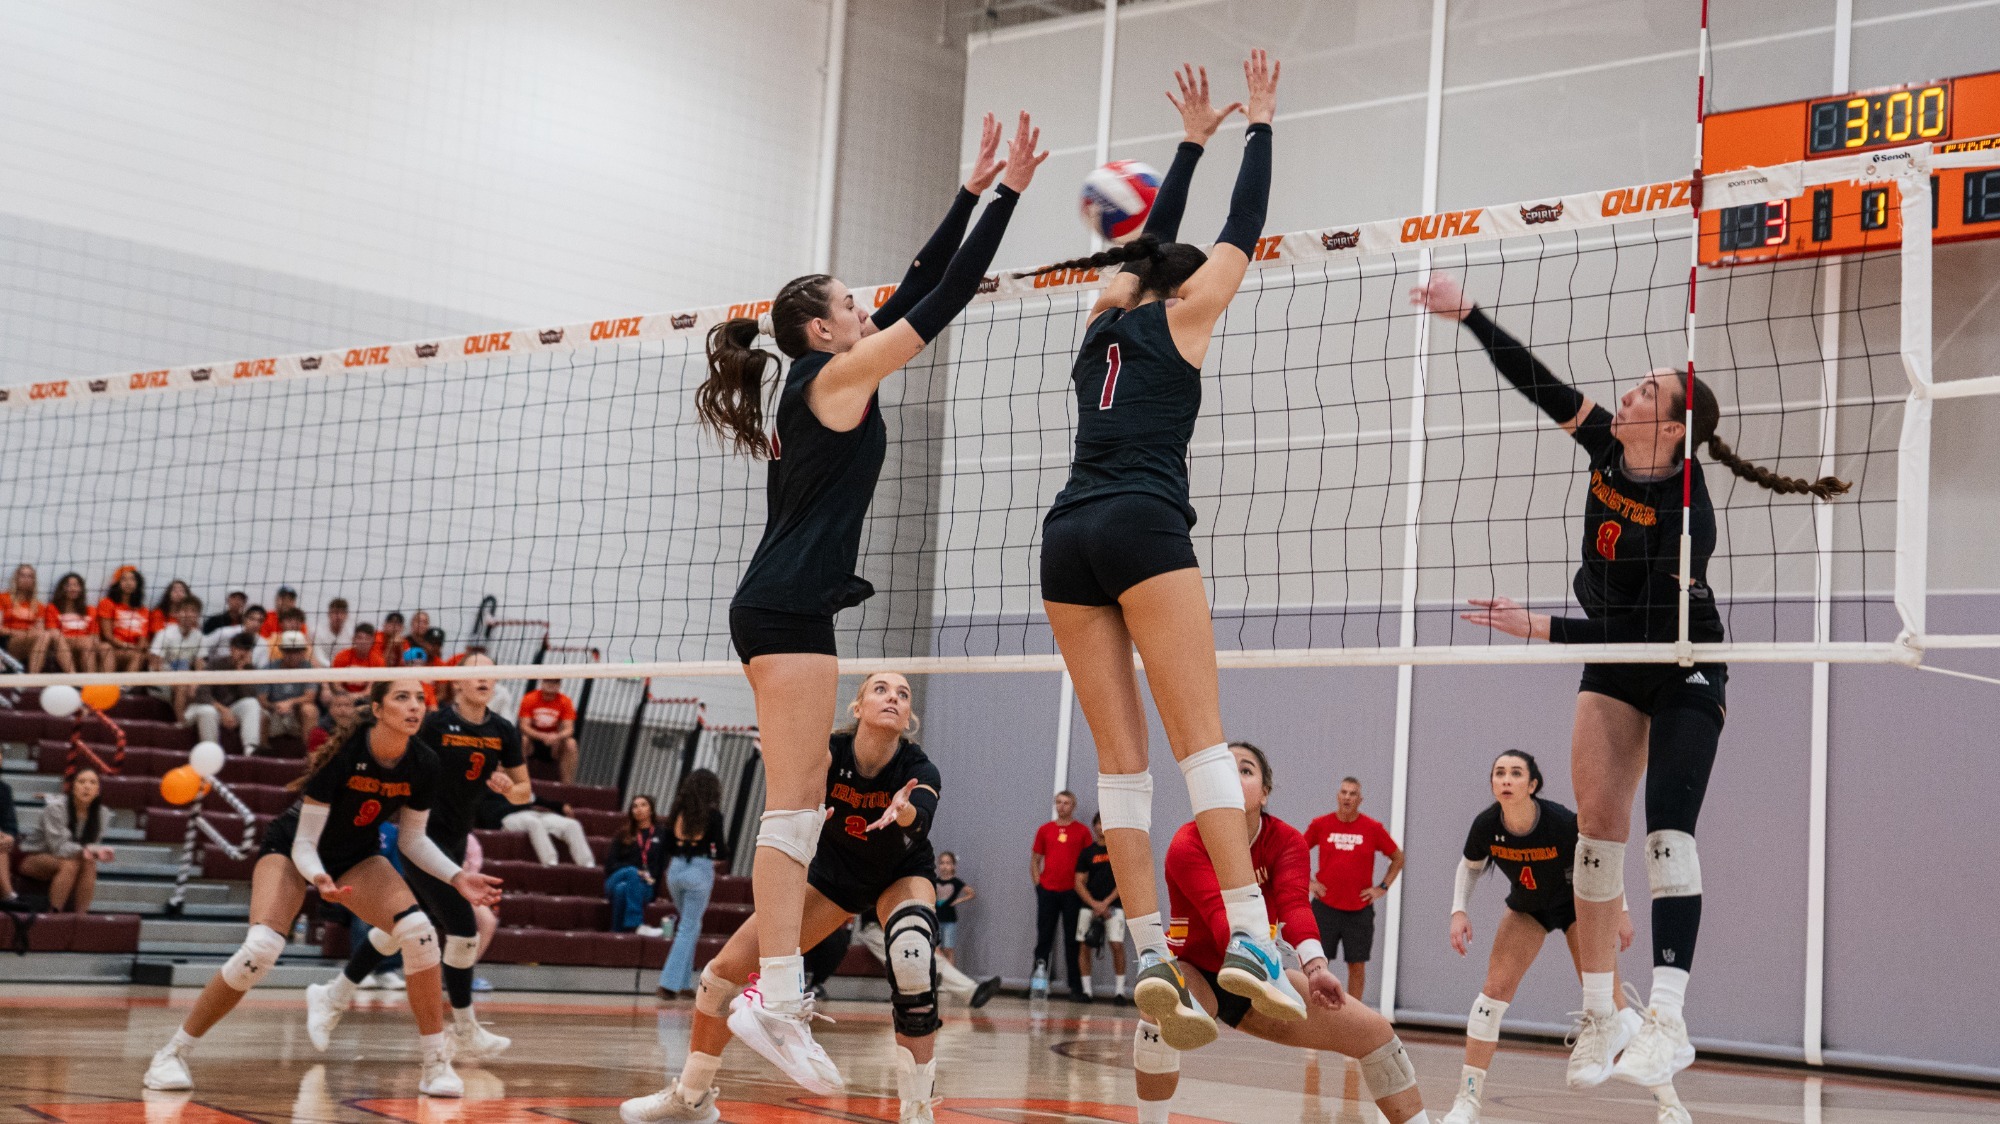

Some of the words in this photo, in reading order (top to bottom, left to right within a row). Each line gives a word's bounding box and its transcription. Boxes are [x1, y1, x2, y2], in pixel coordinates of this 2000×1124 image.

[1845, 87, 1945, 148] 3:00
[1881, 152, 1911, 162] Senoh
[1401, 208, 1484, 243] OUAZ
[1525, 208, 1559, 222] SPIRIT
[1327, 236, 1356, 249] SPIRIT
[589, 317, 643, 341] OUAZ
[464, 332, 512, 355] OUAZ
[1099, 343, 1121, 410] 1
[1597, 520, 1621, 560] 8
[465, 752, 485, 780] 3
[353, 799, 382, 826] 9
[844, 815, 868, 840] 2
[1327, 832, 1364, 845] JESUS
[1519, 866, 1537, 890] 4
